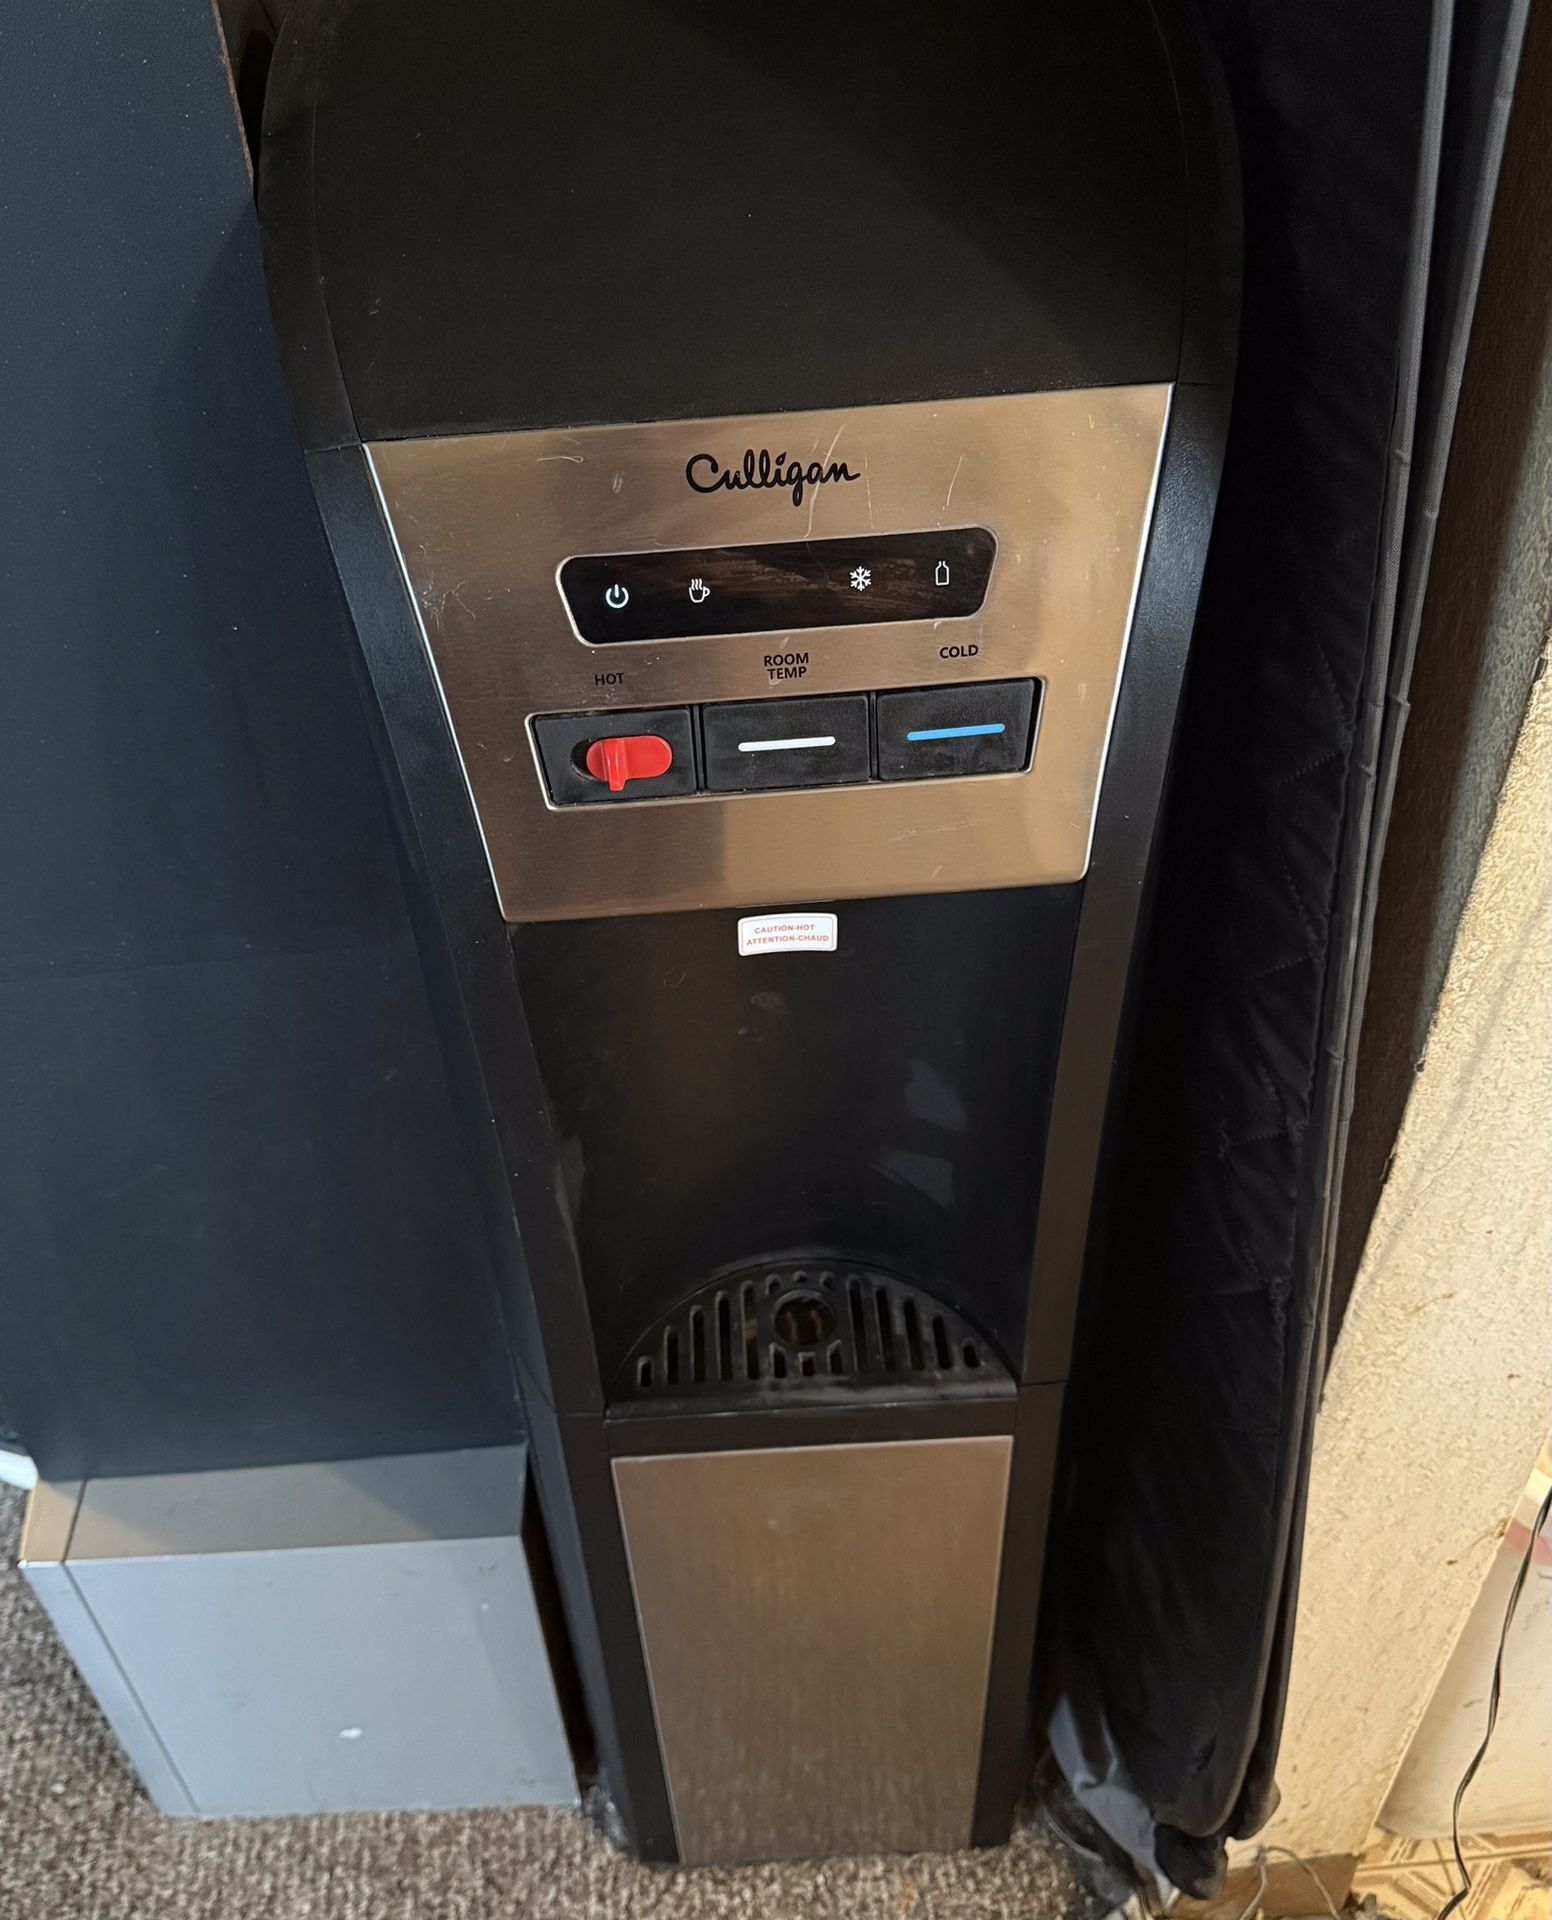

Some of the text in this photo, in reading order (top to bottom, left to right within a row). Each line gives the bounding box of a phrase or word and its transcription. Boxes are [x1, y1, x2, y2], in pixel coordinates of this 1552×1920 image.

[686, 449, 861, 507] Culligan
[939, 644, 979, 659] COLD
[763, 652, 809, 667] ROOM
[594, 672, 625, 686] HOT
[767, 666, 807, 680] TEMP
[754, 923, 816, 934] CAUTION-HOT
[746, 934, 830, 946] ATTENTION-CHAUD
